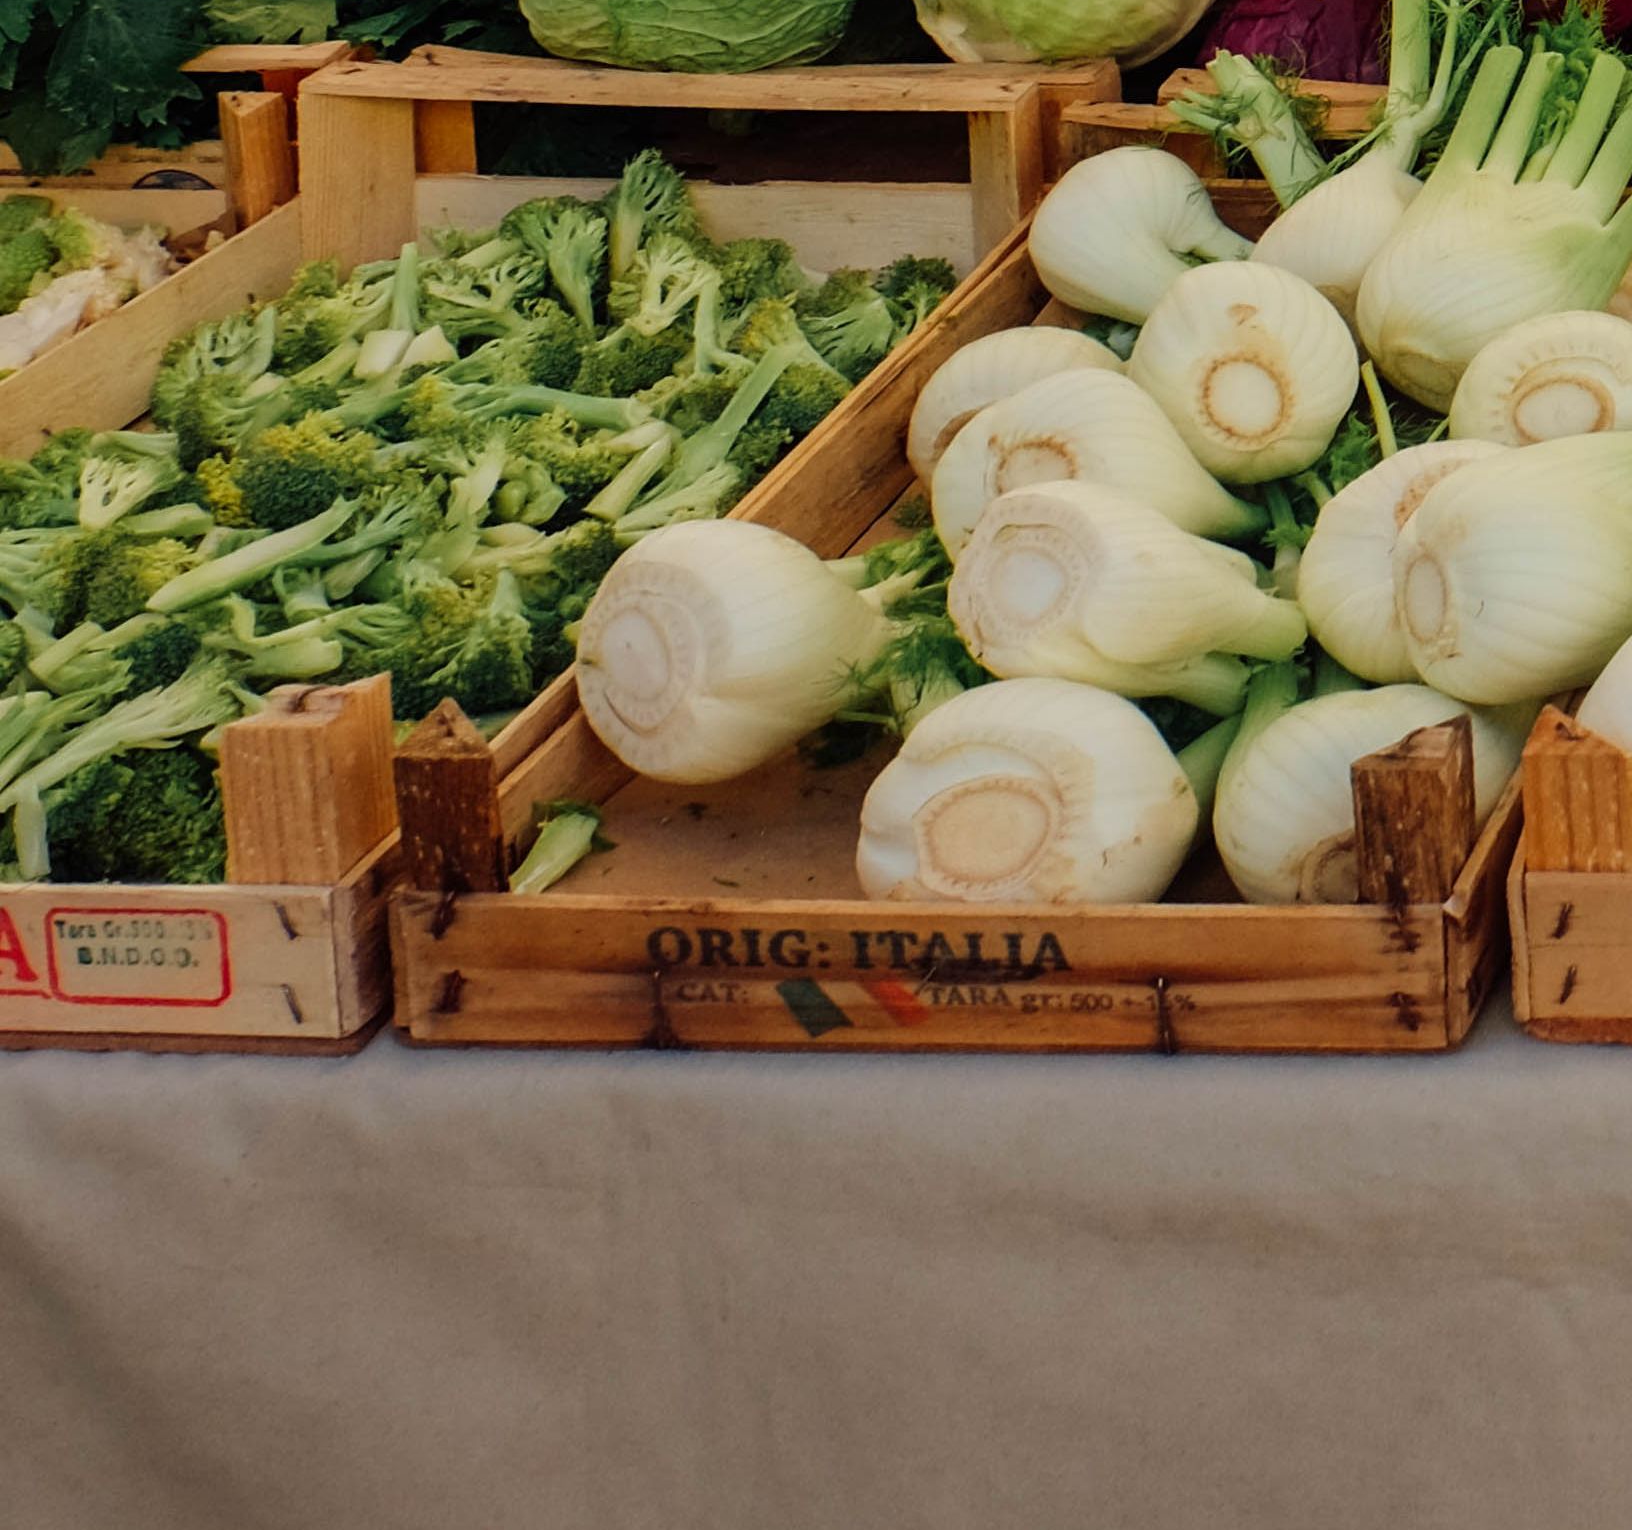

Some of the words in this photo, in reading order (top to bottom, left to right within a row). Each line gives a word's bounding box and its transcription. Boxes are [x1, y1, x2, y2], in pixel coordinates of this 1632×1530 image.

[645, 926, 831, 969] ORIG:
[849, 928, 1073, 971] ITALIA
[929, 984, 1011, 1008] TARA
[1069, 992, 1114, 1012] 500
